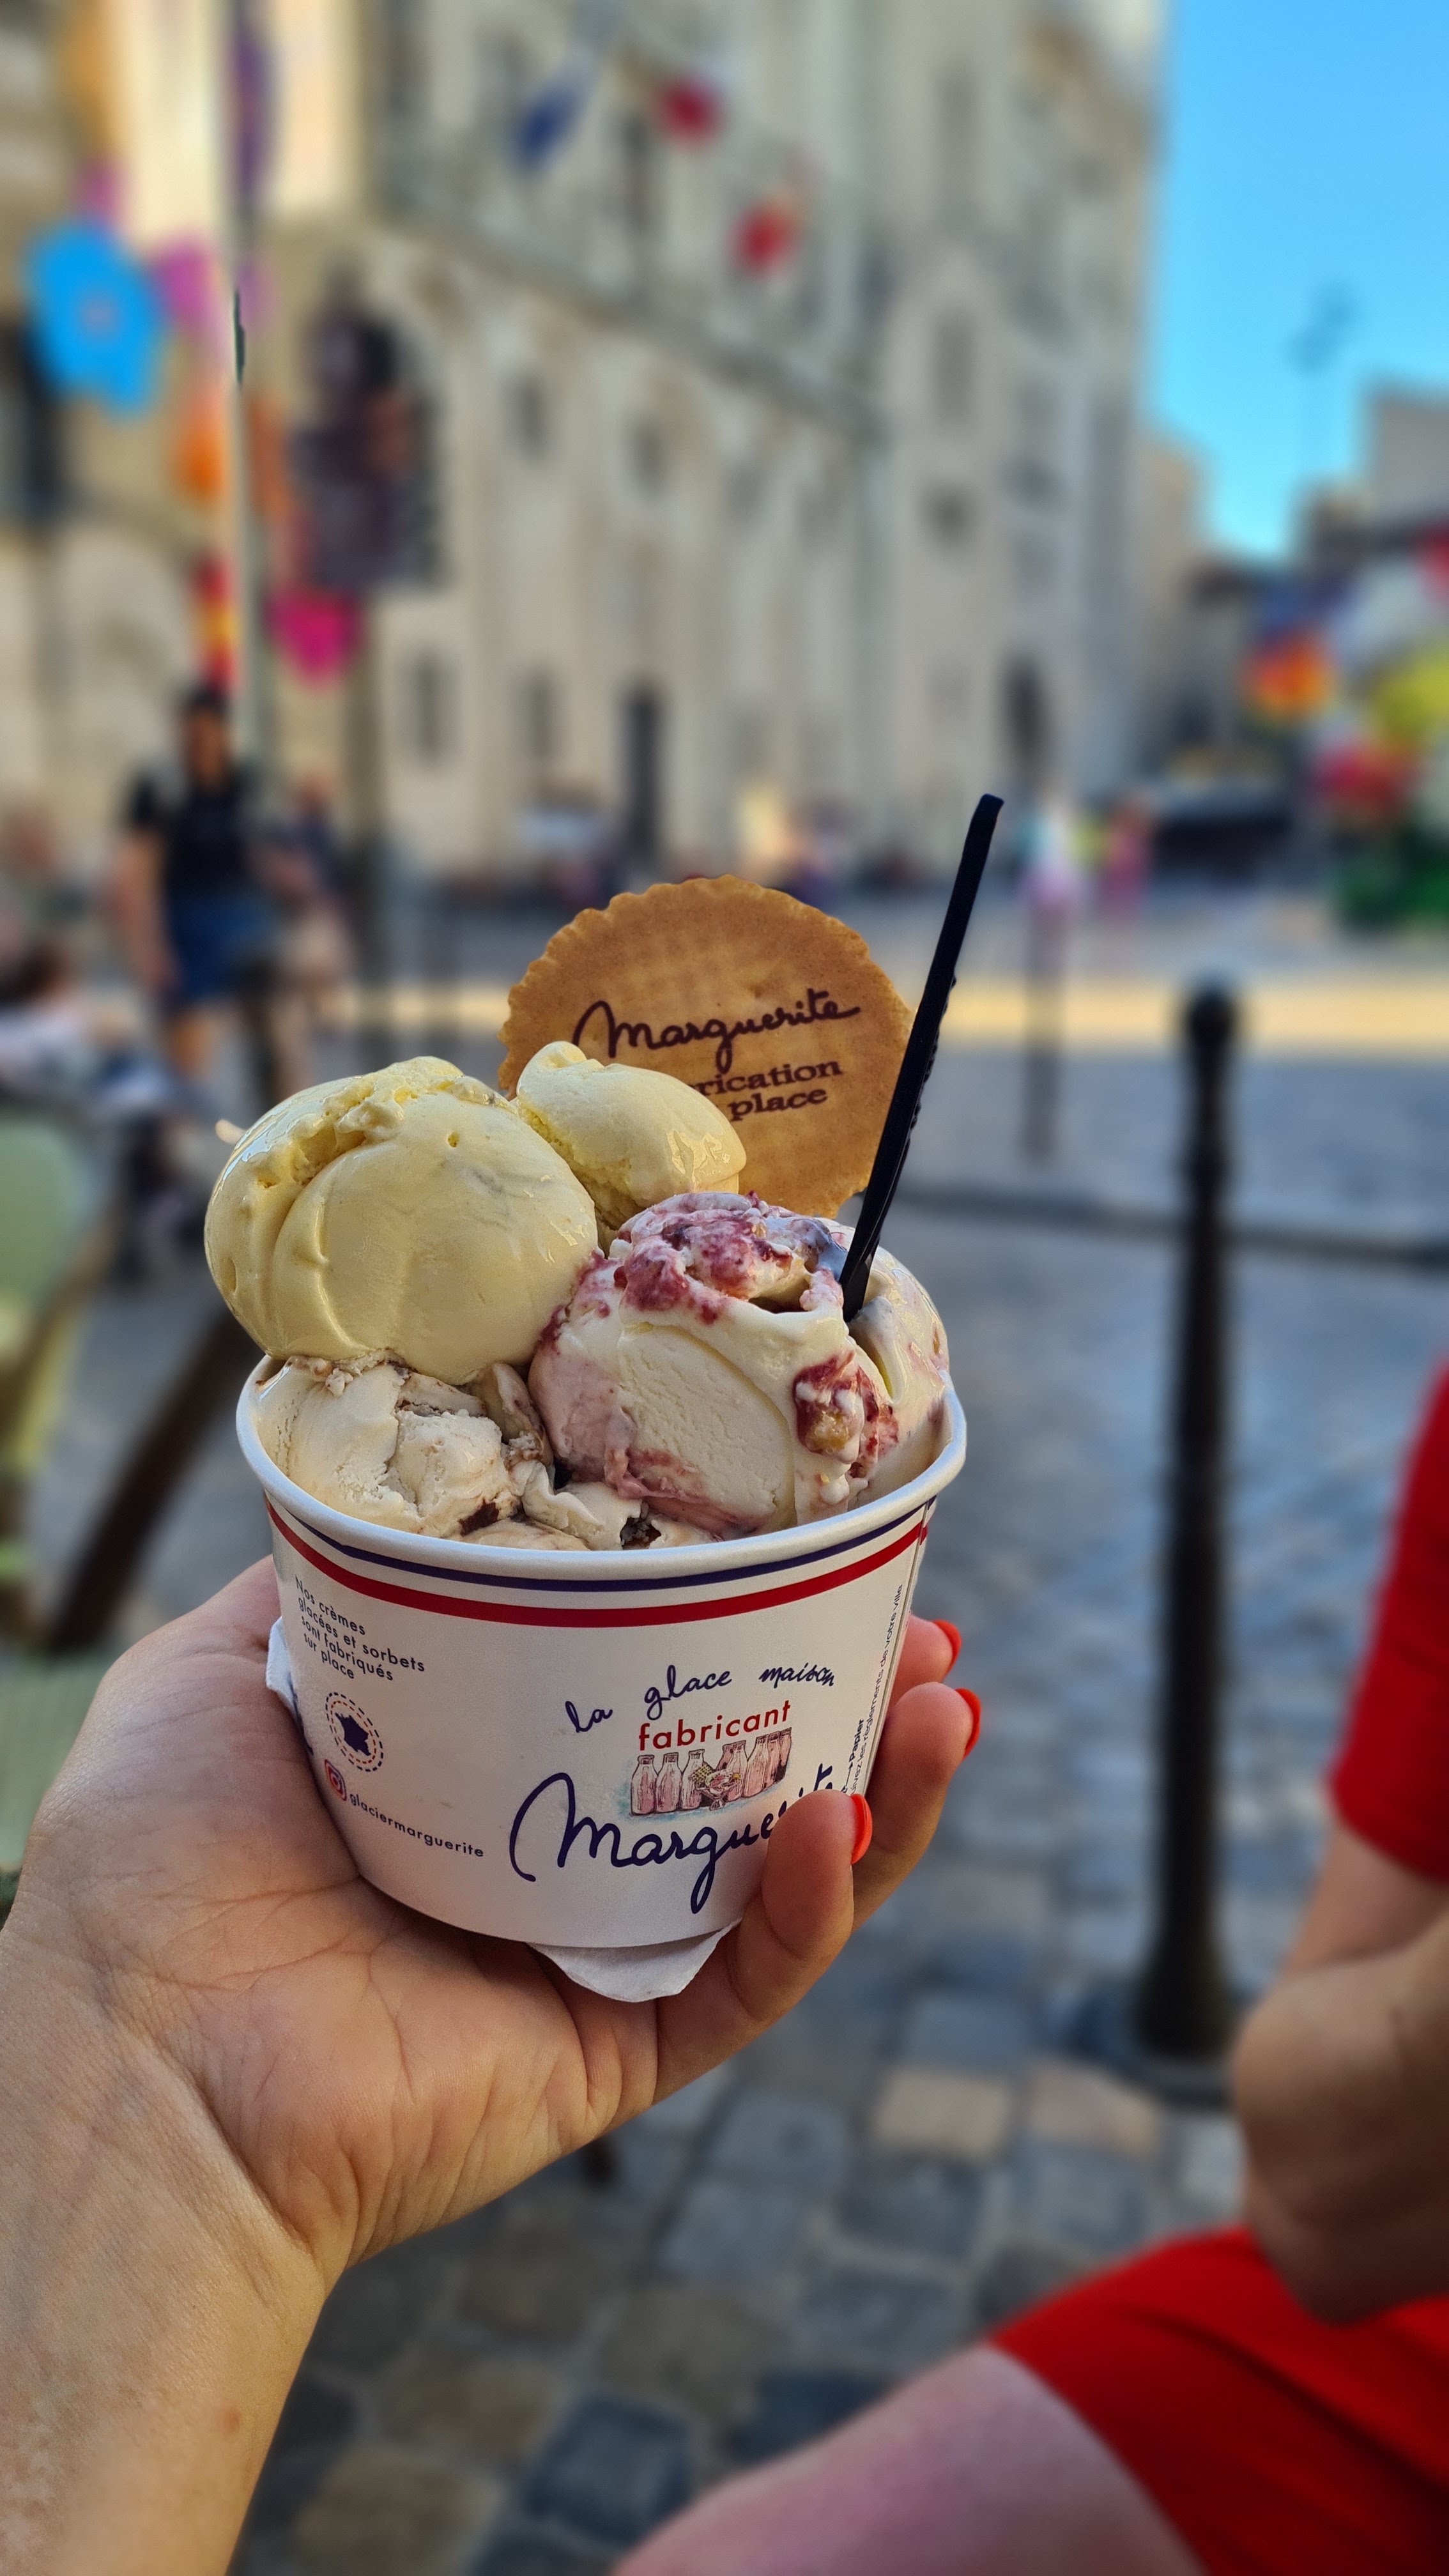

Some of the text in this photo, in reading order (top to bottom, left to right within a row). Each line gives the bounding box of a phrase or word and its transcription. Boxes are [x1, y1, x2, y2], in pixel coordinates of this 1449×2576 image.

[571, 988, 861, 1073] Marguerite
[688, 1060, 843, 1096] rication
[728, 1088, 828, 1122] place
[295, 1574, 365, 1636] Nos crèmes
[893, 1584, 903, 1611] ville
[298, 1597, 425, 1672] glacées et sorbets
[302, 1616, 393, 1680] sont fabriqués
[884, 1612, 897, 1648] votre
[304, 1633, 354, 1679] sur place
[880, 1650, 889, 1667] de
[565, 1663, 834, 1733] la glace maison
[639, 1700, 792, 1751] fabricant
[848, 1719, 864, 1762] Papier
[850, 1761, 862, 1795] uivez
[349, 1793, 484, 1858] glaciermarguerite
[510, 1763, 833, 1914] Marguet
